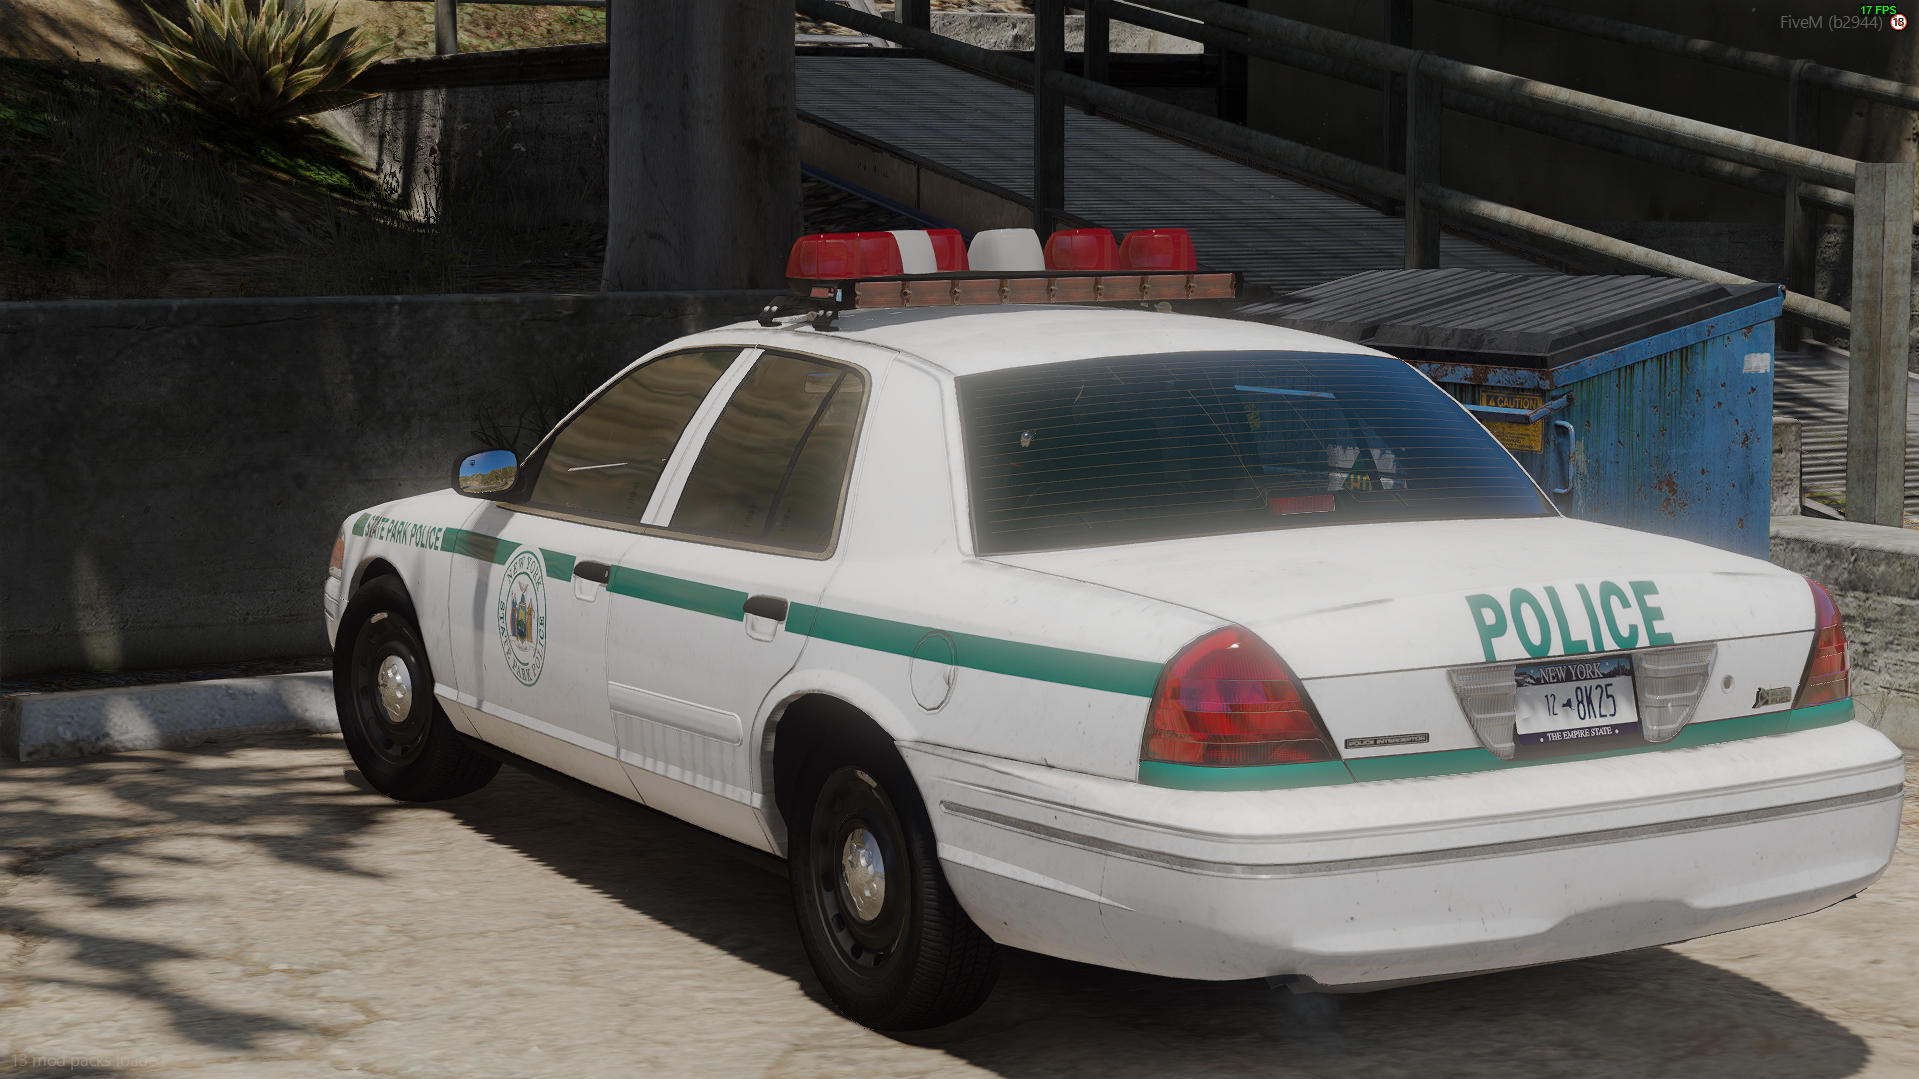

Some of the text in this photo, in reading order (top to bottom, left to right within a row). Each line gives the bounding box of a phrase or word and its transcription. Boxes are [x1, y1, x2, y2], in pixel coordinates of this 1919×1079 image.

[1497, 396, 1536, 410] CAUTION
[365, 514, 443, 551] STATE PARK POLICE
[507, 556, 543, 592] NEW YORK
[1465, 580, 1675, 662] POLICE
[512, 658, 532, 682] PARK
[531, 616, 545, 677] POLICE
[1539, 662, 1604, 684] NEW YORK
[1544, 683, 1617, 721] 12 8K25
[1770, 689, 1790, 697] FLEX
[1547, 726, 1613, 741] THE EMPIRE STATE
